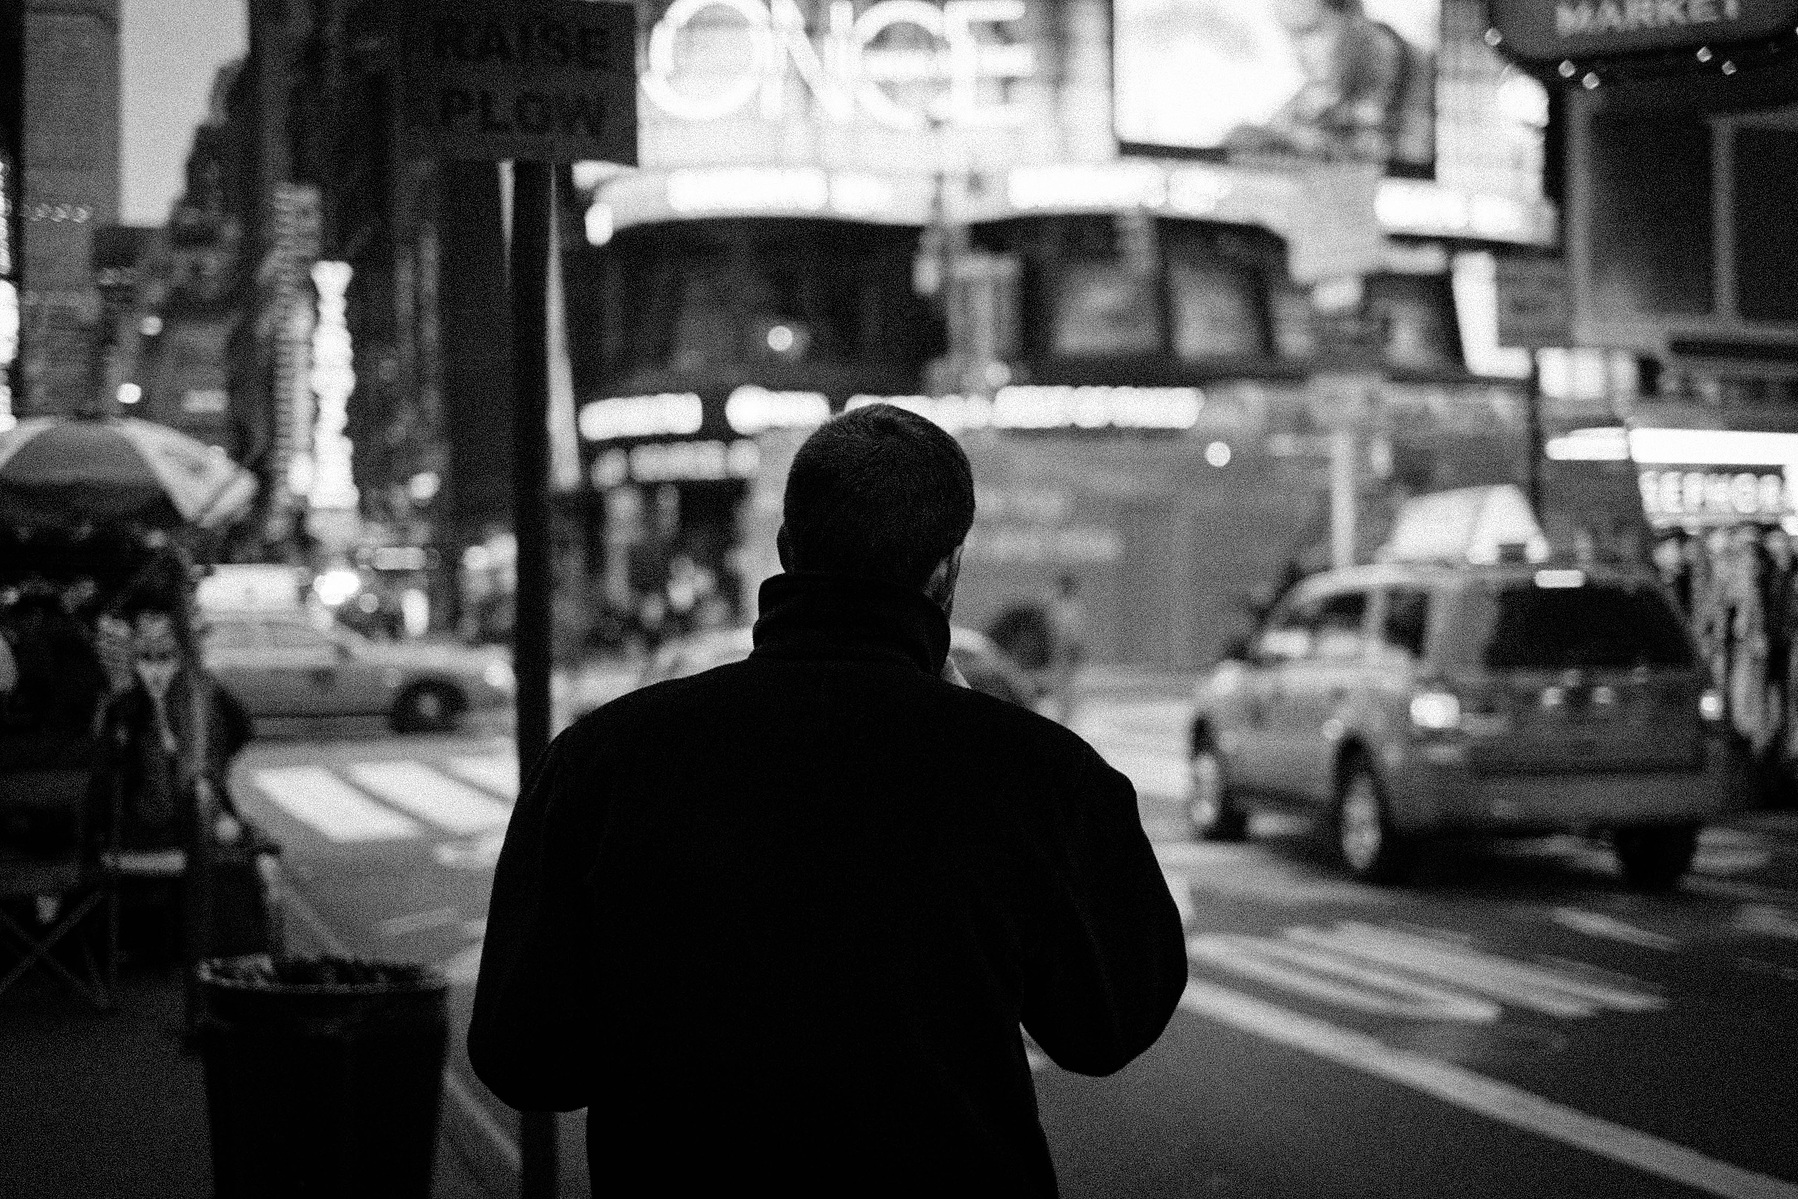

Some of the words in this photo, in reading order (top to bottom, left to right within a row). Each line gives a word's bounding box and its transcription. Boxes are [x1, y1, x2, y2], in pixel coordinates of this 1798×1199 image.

[1555, 0, 1739, 36] MARKET
[434, 21, 608, 70] RAISE
[440, 89, 604, 136] PLOW
